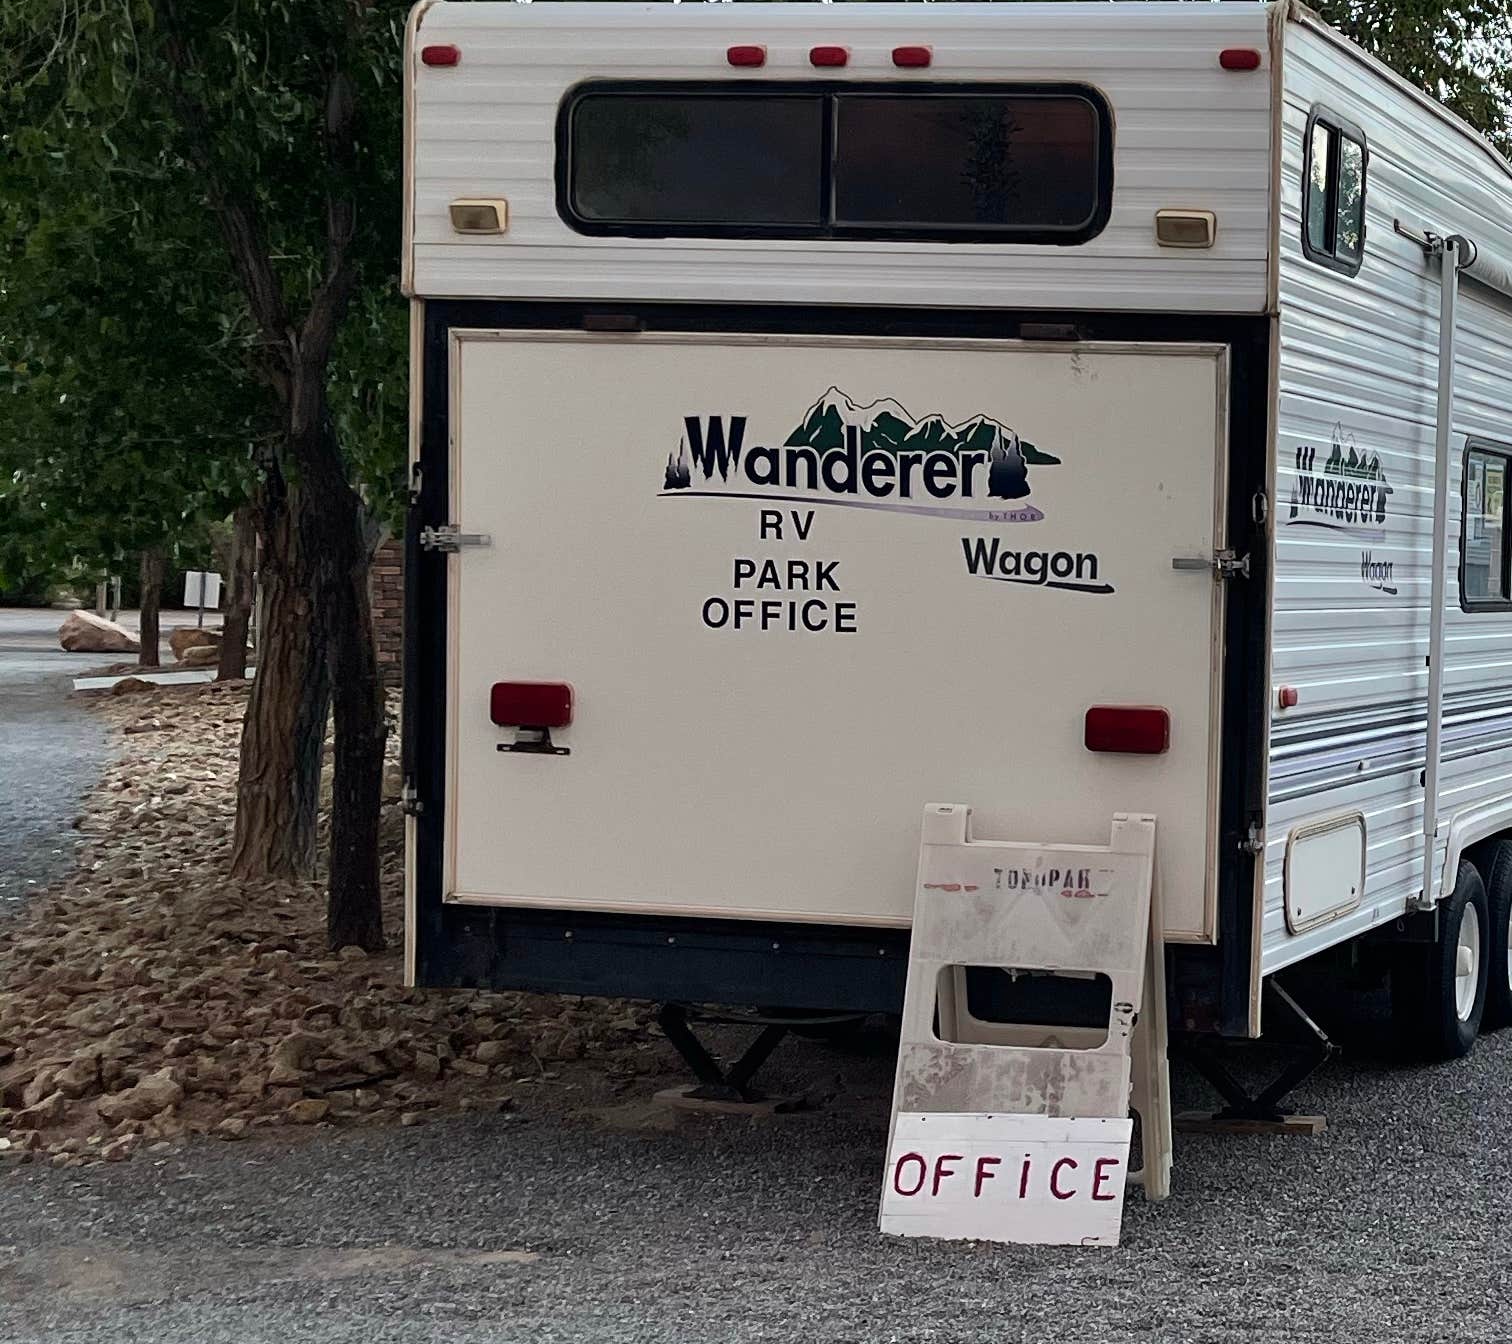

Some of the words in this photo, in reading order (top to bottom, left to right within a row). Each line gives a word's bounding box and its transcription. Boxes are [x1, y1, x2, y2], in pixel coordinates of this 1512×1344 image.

[684, 416, 988, 497] Wanderer
[1294, 446, 1378, 524] Wanderer
[760, 509, 815, 540] RV
[733, 558, 841, 592] PARK
[961, 537, 1098, 586] Wagon
[702, 597, 858, 633] OFFICE
